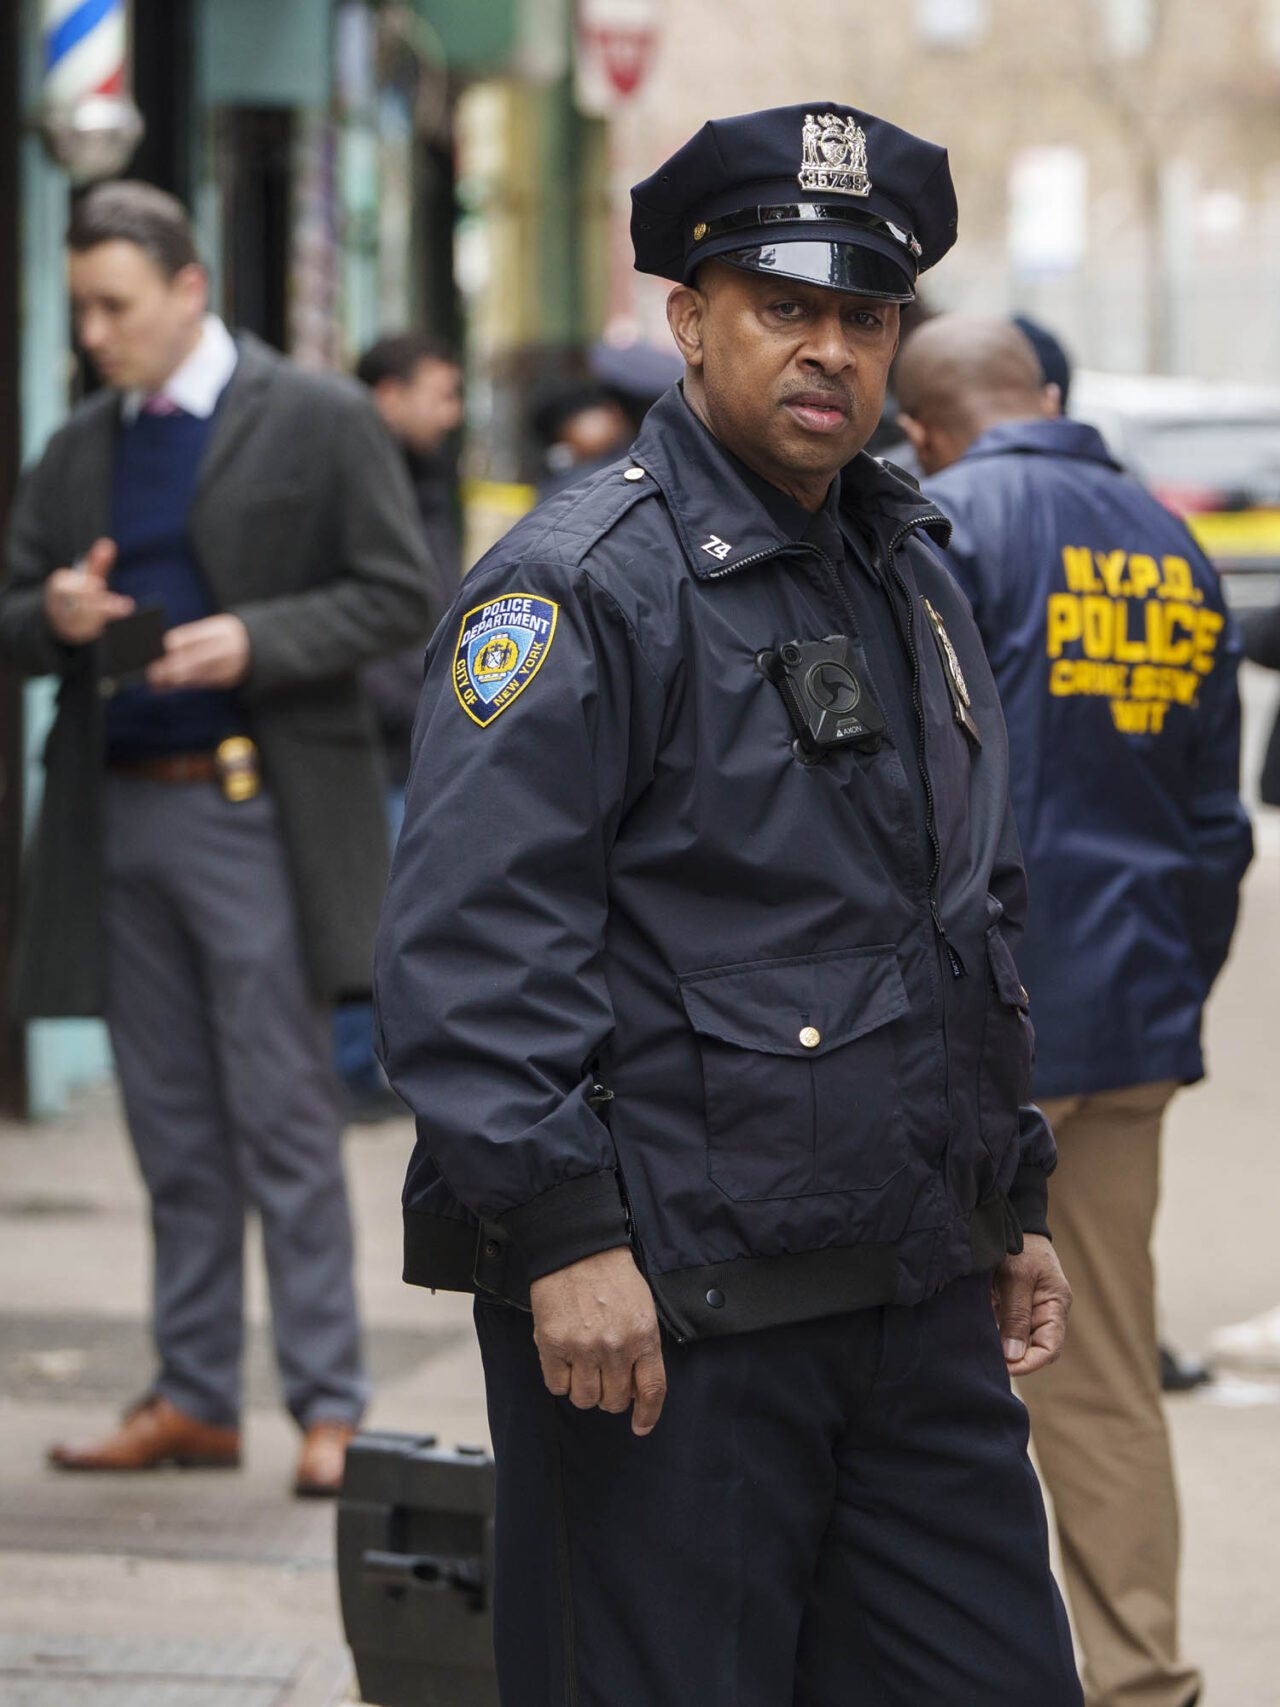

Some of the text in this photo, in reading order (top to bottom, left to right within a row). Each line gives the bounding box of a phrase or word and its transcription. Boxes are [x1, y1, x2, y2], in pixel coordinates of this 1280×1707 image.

[700, 534, 732, 560] 74
[482, 598, 533, 621] POLICE
[460, 612, 551, 648] DEPARTMENT
[1046, 592, 1225, 675] POLICE
[456, 641, 545, 707] CITY OF NEW YORK
